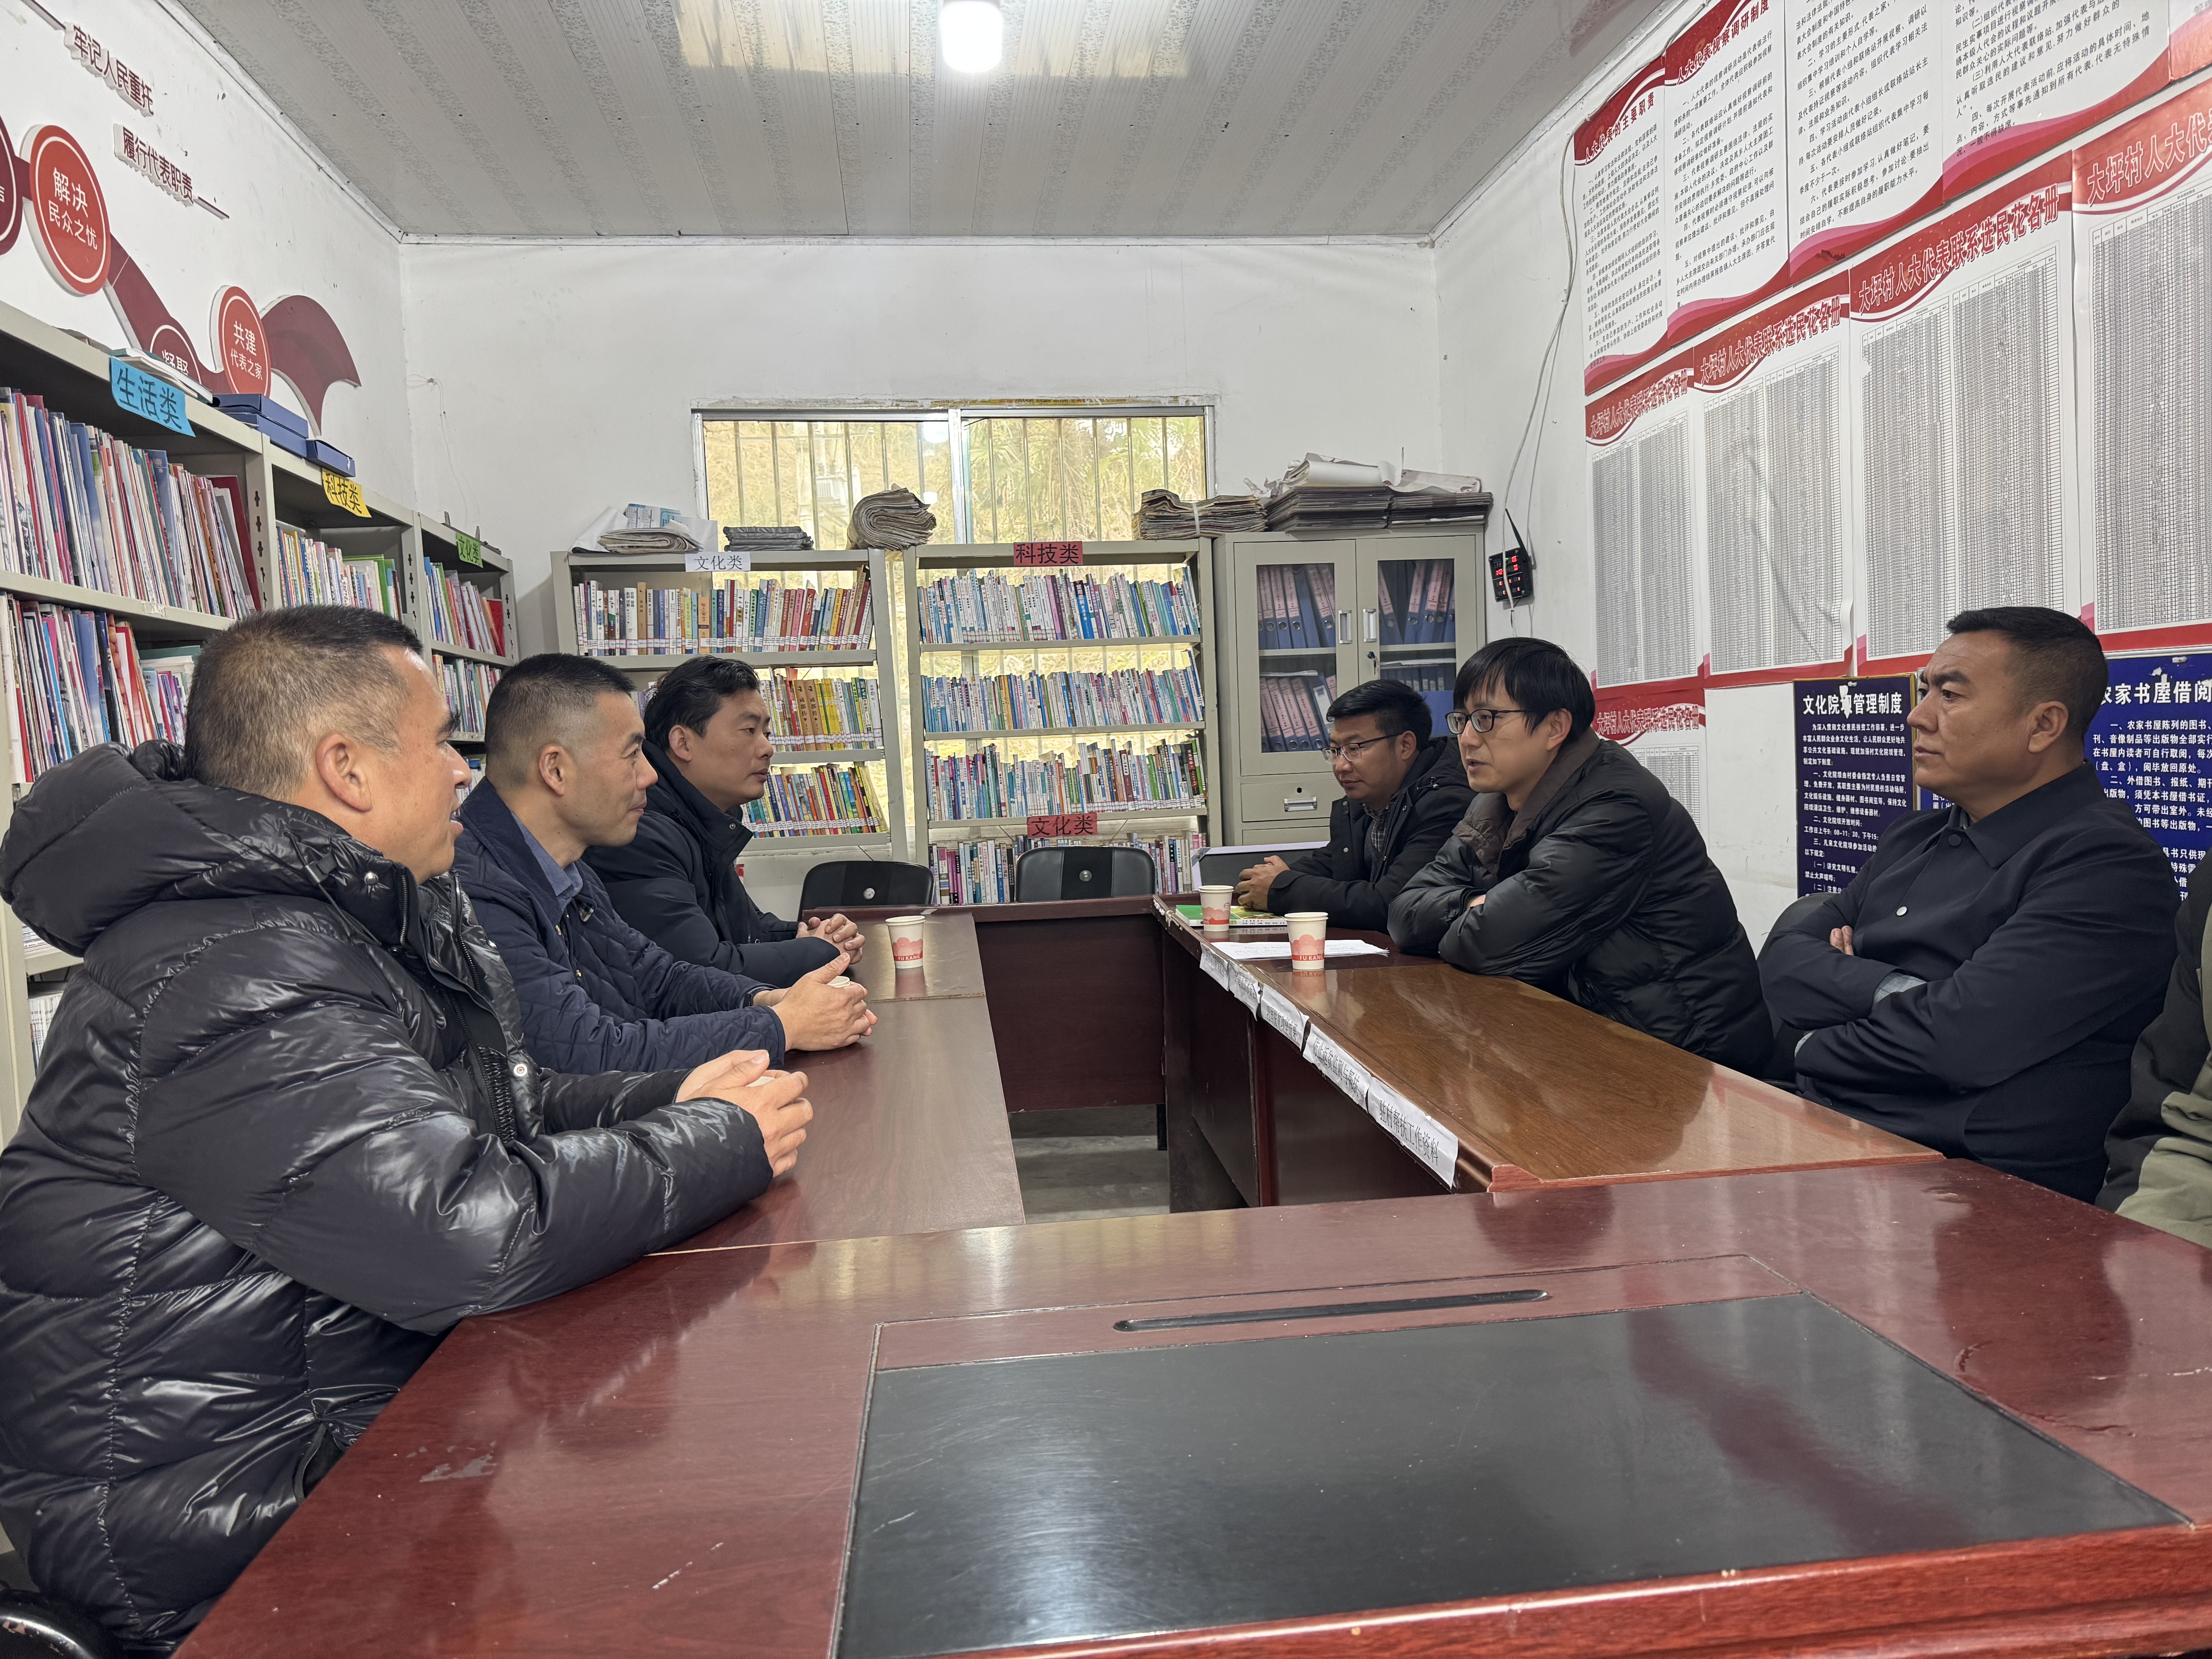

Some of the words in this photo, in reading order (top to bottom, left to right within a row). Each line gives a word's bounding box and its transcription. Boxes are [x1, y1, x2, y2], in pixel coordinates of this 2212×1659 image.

[1676, 0, 1769, 85] 人大代表视察调研制度
[74, 26, 153, 116] 牢记人民重托
[1585, 91, 1654, 164] 人大代表的主要职责
[123, 126, 194, 204] 履行代表职责
[53, 167, 88, 218] 解决
[48, 201, 98, 251] 民众之忧
[1859, 183, 2059, 316] 大坪村人大代表联系选民花名册
[233, 321, 256, 356] 共建
[1700, 294, 1841, 386] 大坪村人大代表联系选民花名册
[230, 348, 263, 381] 代表之家
[116, 366, 182, 429] 生活类
[1590, 368, 1688, 440] 大坪村人大代表联系选民花名册
[325, 473, 362, 514] 科技类
[457, 536, 480, 565] 文化类
[694, 555, 742, 570] 文化类
[1016, 544, 1079, 564] 科技类
[1597, 704, 1700, 735] 大坪村人大代表联系选民花名册
[2110, 720, 2211, 730] 一、农家书屋陈列的图书、
[1031, 815, 1095, 836] 文化类
[1379, 1100, 1439, 1166] 驻村帮扶工作资料
